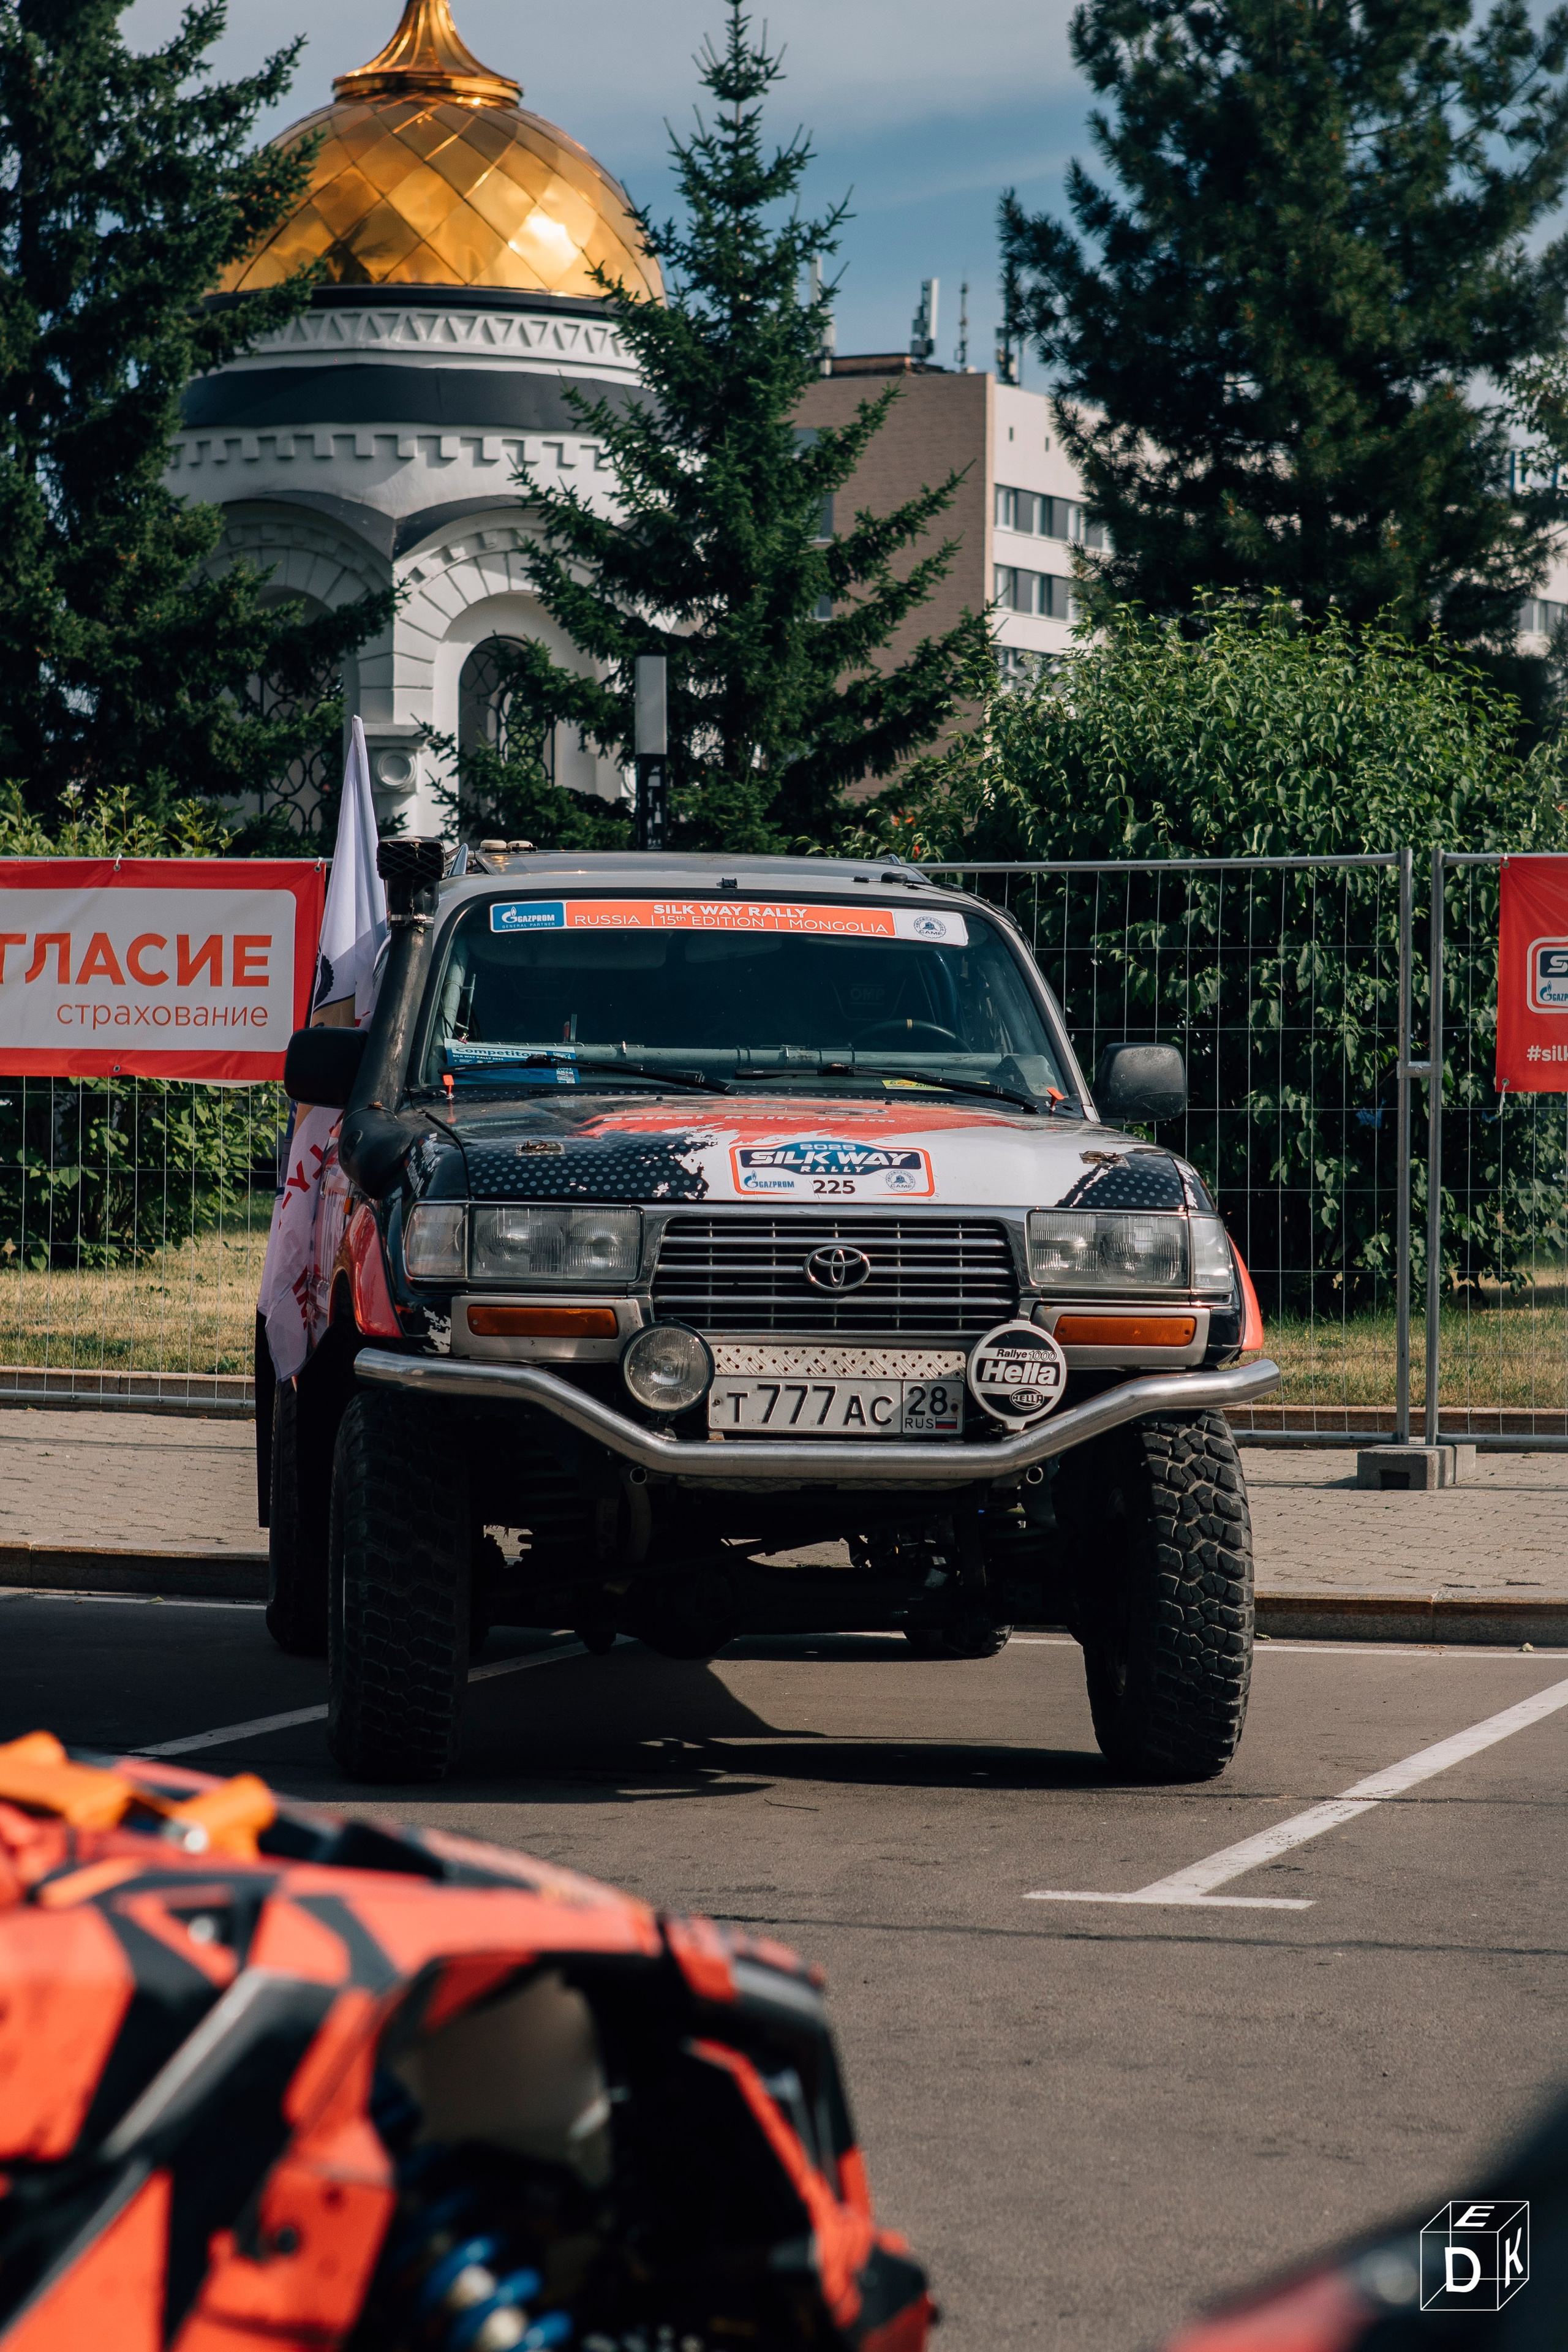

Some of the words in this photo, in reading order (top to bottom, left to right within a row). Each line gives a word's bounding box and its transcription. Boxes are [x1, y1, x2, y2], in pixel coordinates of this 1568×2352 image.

[653, 904, 695, 915] SILK
[699, 905, 743, 916] WAY
[748, 907, 807, 918] RALLY
[517, 914, 555, 923] GAZPROM
[575, 914, 641, 925] RUSSIA
[660, 914, 687, 925] 15th
[692, 916, 765, 928] EDITION
[789, 919, 889, 934] MONGOLIA
[57, 1004, 268, 1030] страхование
[749, 1151, 833, 1165] SILK
[837, 1152, 911, 1166] WAY
[813, 1180, 856, 1194] 225
[997, 1349, 1027, 1359] Rallye
[1028, 1350, 1057, 1361] 1000
[981, 1360, 1056, 1385] Hella
[908, 1385, 948, 1416] 28
[905, 1417, 934, 1429] RUS
